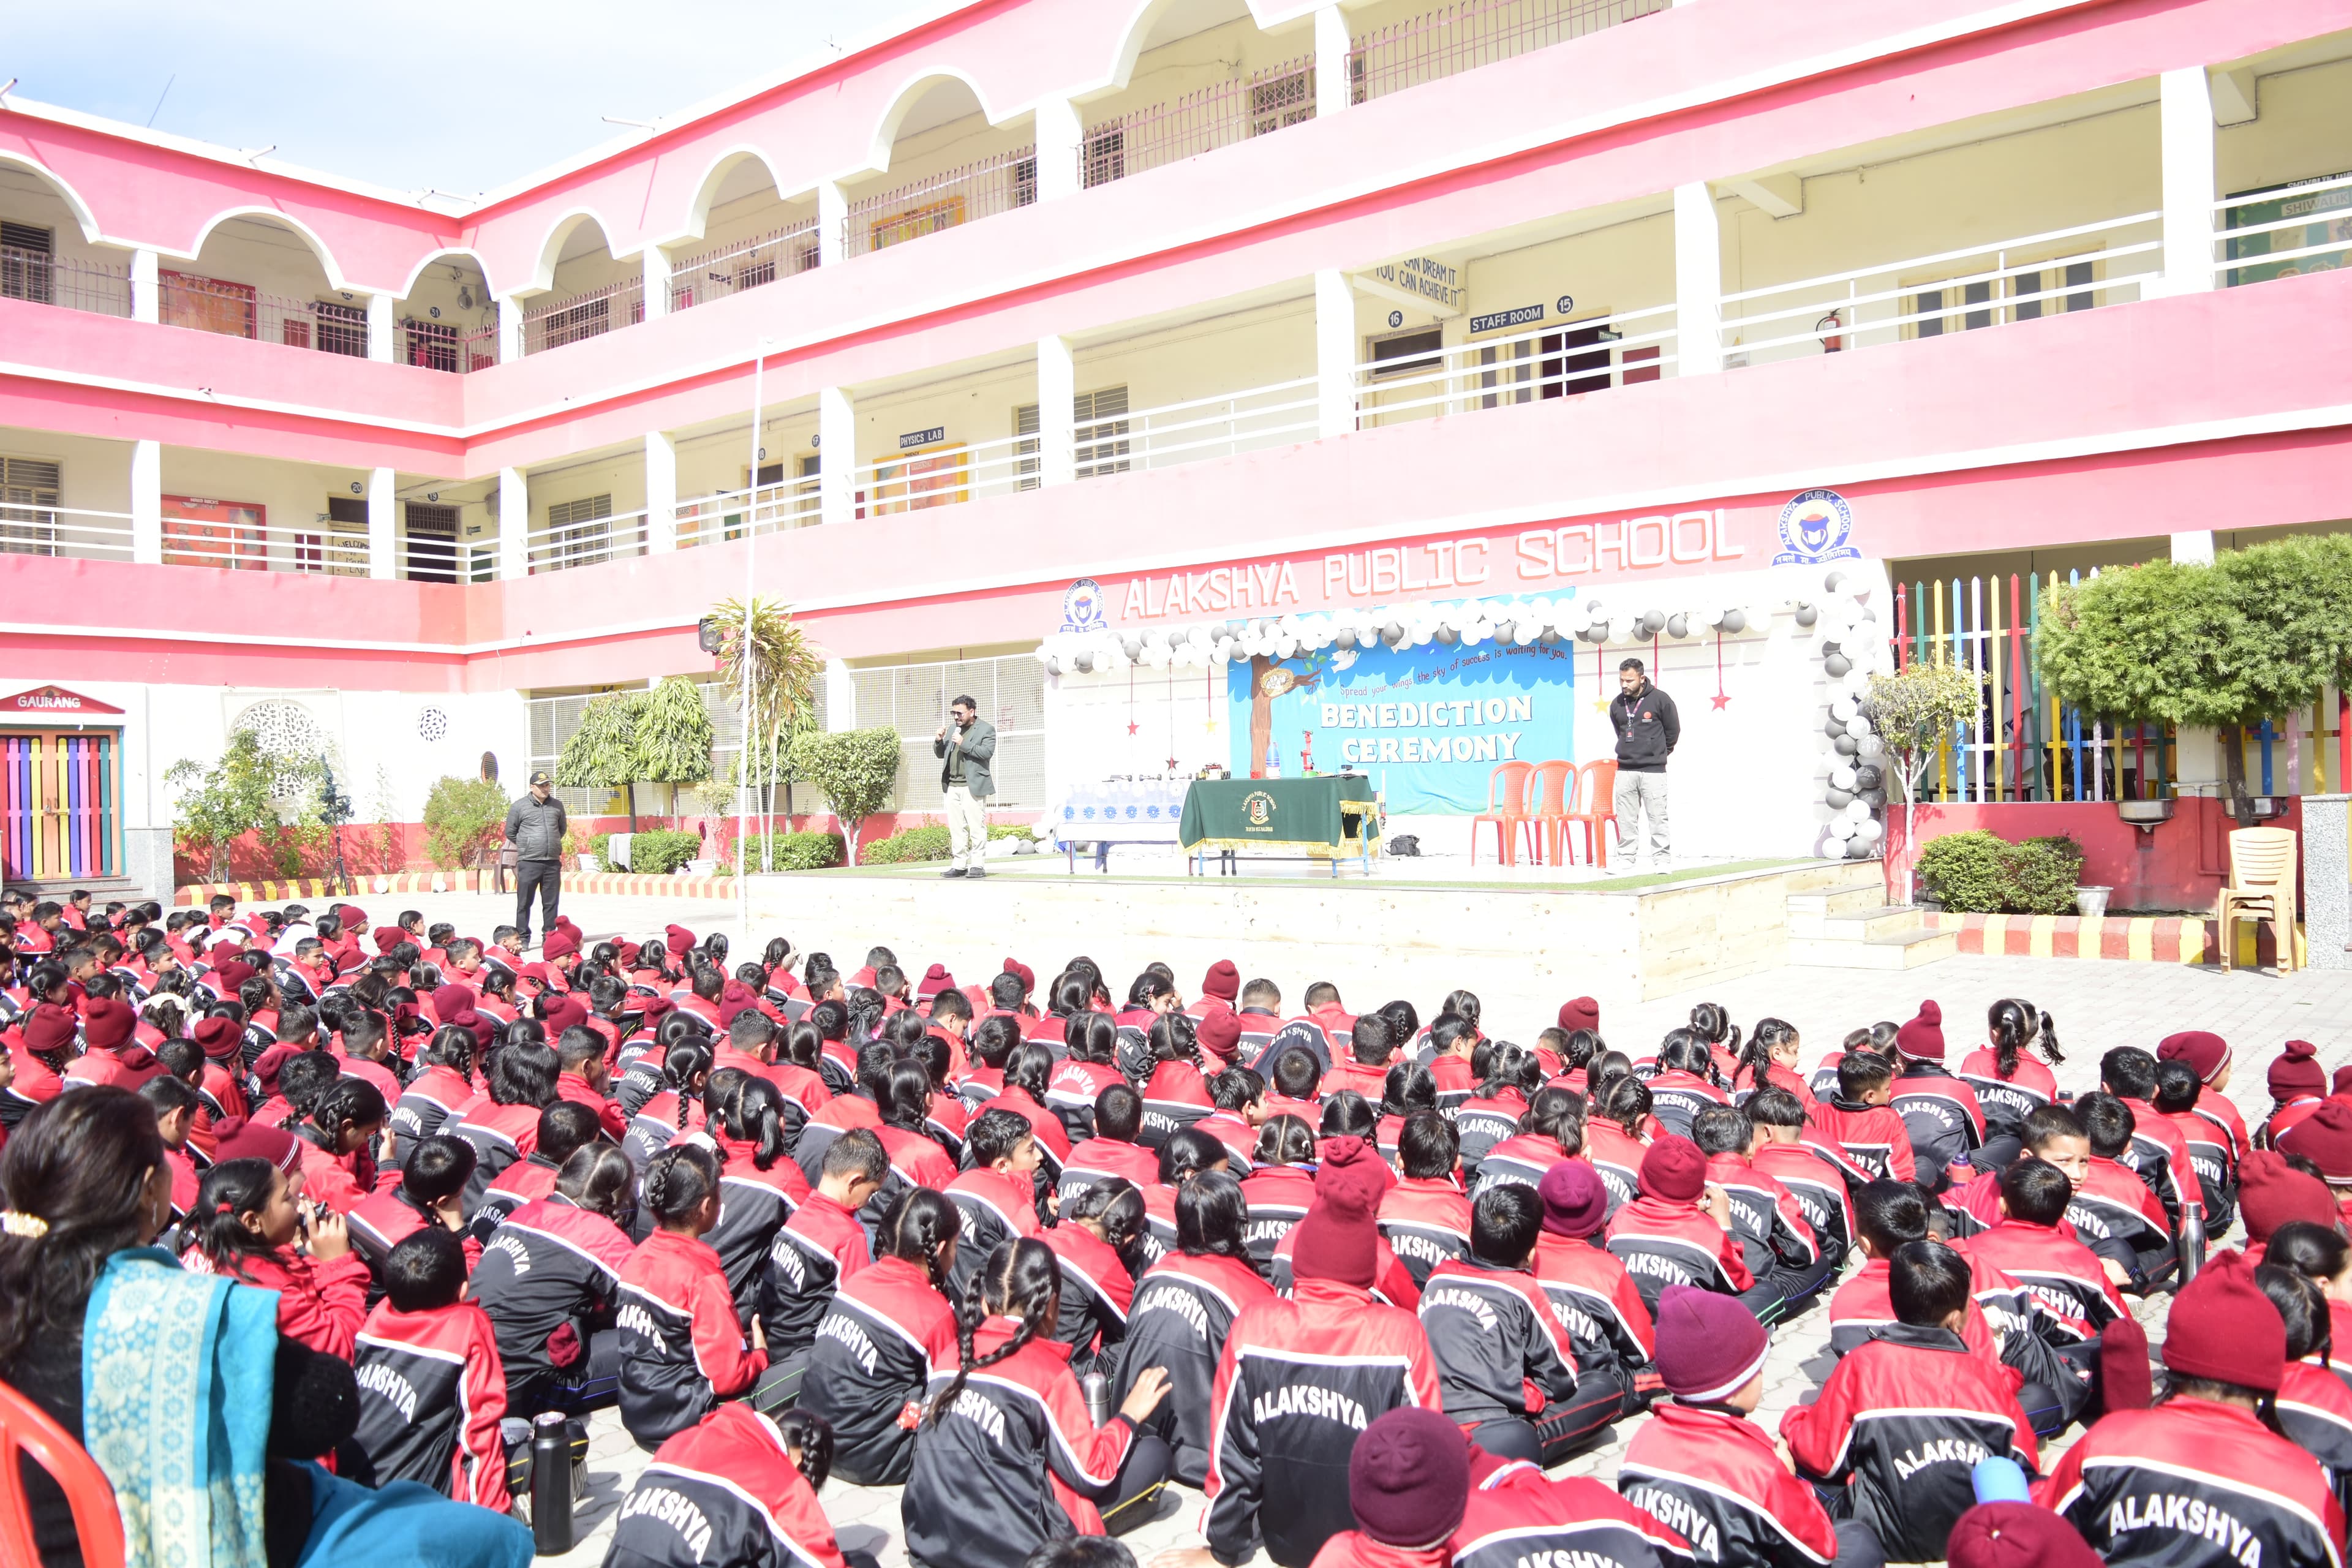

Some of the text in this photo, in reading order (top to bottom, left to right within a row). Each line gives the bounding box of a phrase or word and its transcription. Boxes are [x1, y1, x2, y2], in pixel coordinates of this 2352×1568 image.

[2285, 192, 2348, 215] SHIWALIK
[1423, 257, 1447, 283] DREAM
[1449, 268, 1456, 285] IT
[1400, 270, 1416, 292] CAN
[1419, 277, 1449, 304] ACHIEVE
[430, 308, 440, 317] 31
[1390, 312, 1400, 326] 16
[1472, 307, 1541, 331] STAFF ROOM
[1559, 298, 1572, 312] 15
[812, 435, 819, 446] 17
[900, 429, 942, 447] PHYSICS LAB
[352, 483, 362, 492] 20
[1780, 491, 1850, 545] ALAKSHYA PUBLIC SCHOOL
[1121, 508, 1745, 620] ALAKSHYA PUBLIC SCHOOL
[1340, 684, 1368, 698] Spread
[1371, 684, 1387, 698] your
[1417, 670, 1430, 682] the
[1432, 666, 1446, 679] sky
[1450, 655, 1459, 672] of
[1461, 652, 1490, 667] success
[1494, 649, 1502, 659] is
[1506, 644, 1536, 657] waiting
[1539, 643, 1550, 655] for
[18, 696, 81, 708] GAURANG
[1320, 695, 1533, 729] BENEDICTION
[1341, 732, 1523, 764] CEREMONY
[1117, 1037, 1134, 1055] SHYA
[1237, 1041, 1262, 1057] KSHY
[622, 1071, 657, 1093] LAKSHYA
[1653, 1093, 1701, 1115] AKSHYA
[1896, 1101, 1953, 1128] LAKSHYA
[390, 1107, 422, 1136] LAKSHYA
[1457, 1118, 1513, 1142] LAKSHY
[627, 1125, 656, 1156] LAKSHYA
[1848, 1152, 1883, 1178] SHYA
[2190, 1156, 2221, 1182] SHYA
[1594, 1168, 1631, 1204] SHYA
[1243, 1220, 1293, 1243] LAKS
[1728, 1197, 1762, 1238] SHYA
[1392, 1234, 1452, 1262] AKSHY
[769, 1242, 805, 1294] AKSHYA
[1620, 1252, 1692, 1286] AKSHYA
[1551, 1302, 1596, 1344] SHYA
[355, 1363, 417, 1424] LAKSHYA
[1254, 1385, 1367, 1431] ALAKSHYA
[1893, 1439, 1989, 1480] ALAKSH
[619, 1488, 712, 1565] LAKSHYA
[1623, 1487, 1719, 1564] AKSHYA
[2109, 1494, 2262, 1568] ALAKSHYA
